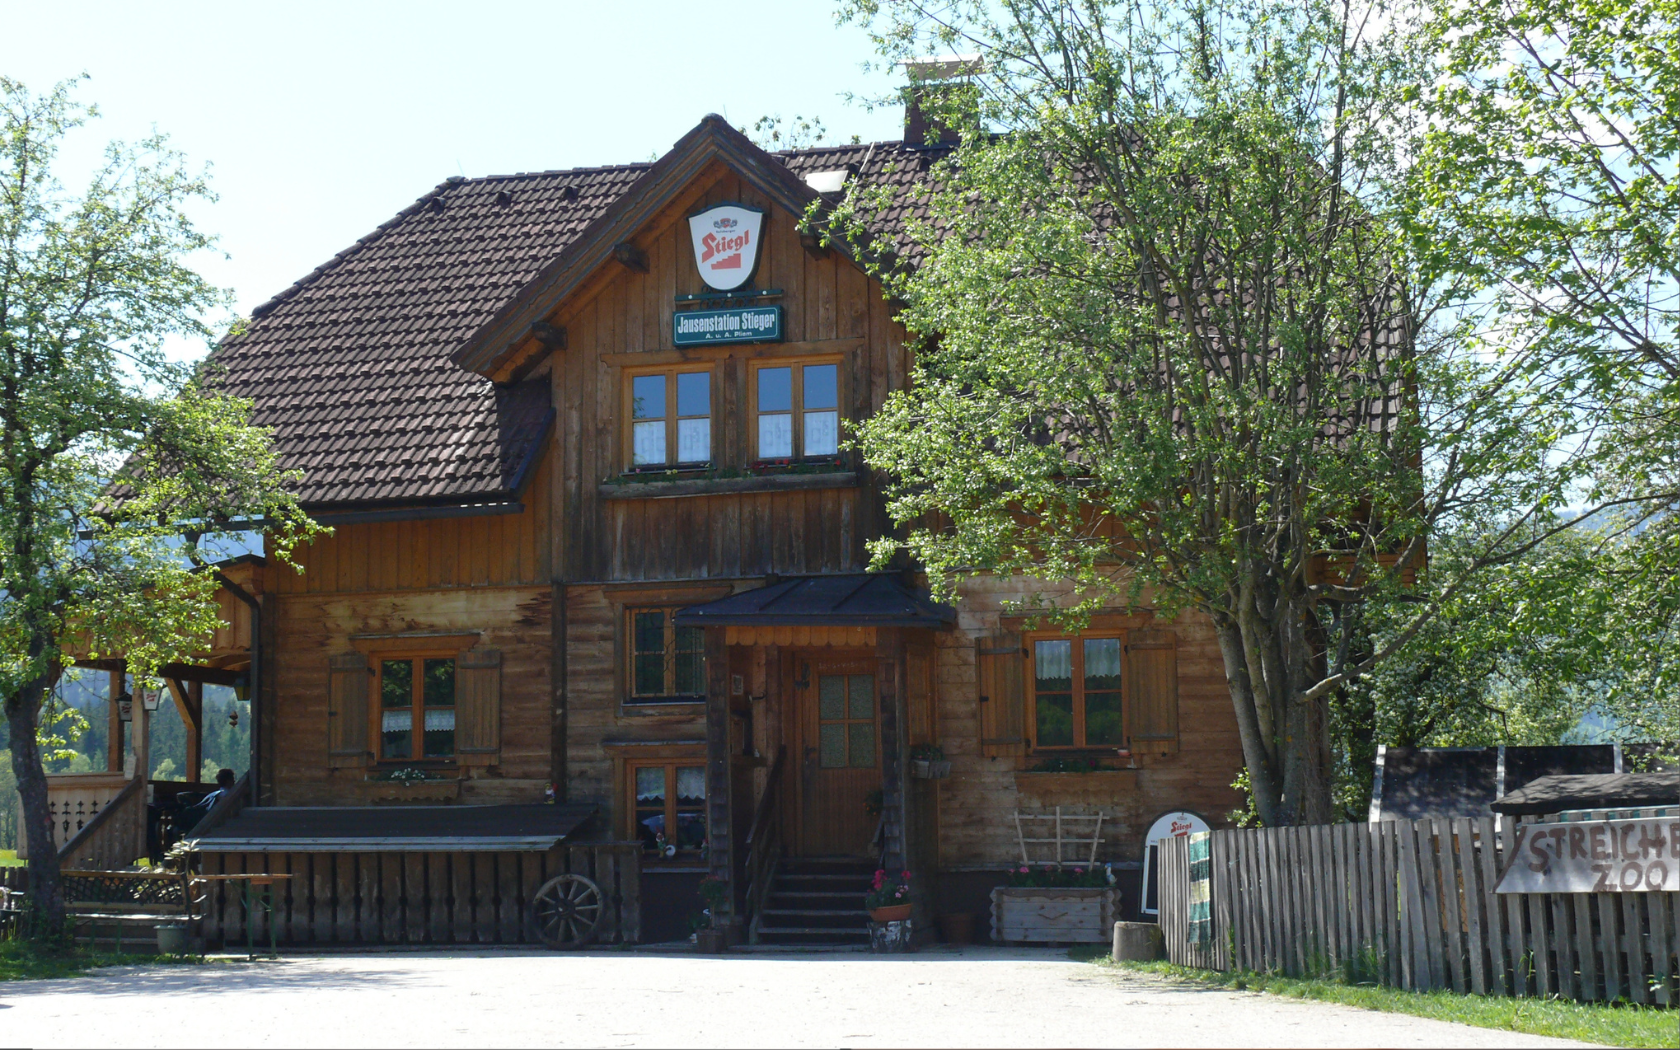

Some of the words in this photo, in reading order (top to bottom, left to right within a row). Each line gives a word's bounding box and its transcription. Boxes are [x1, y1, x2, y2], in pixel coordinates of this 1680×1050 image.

[702, 229, 750, 264] Stiegl
[677, 313, 740, 334] Jausenstation
[741, 312, 775, 332] Stieger
[1170, 821, 1192, 833] Stiegl
[1590, 859, 1669, 892] ZOO
